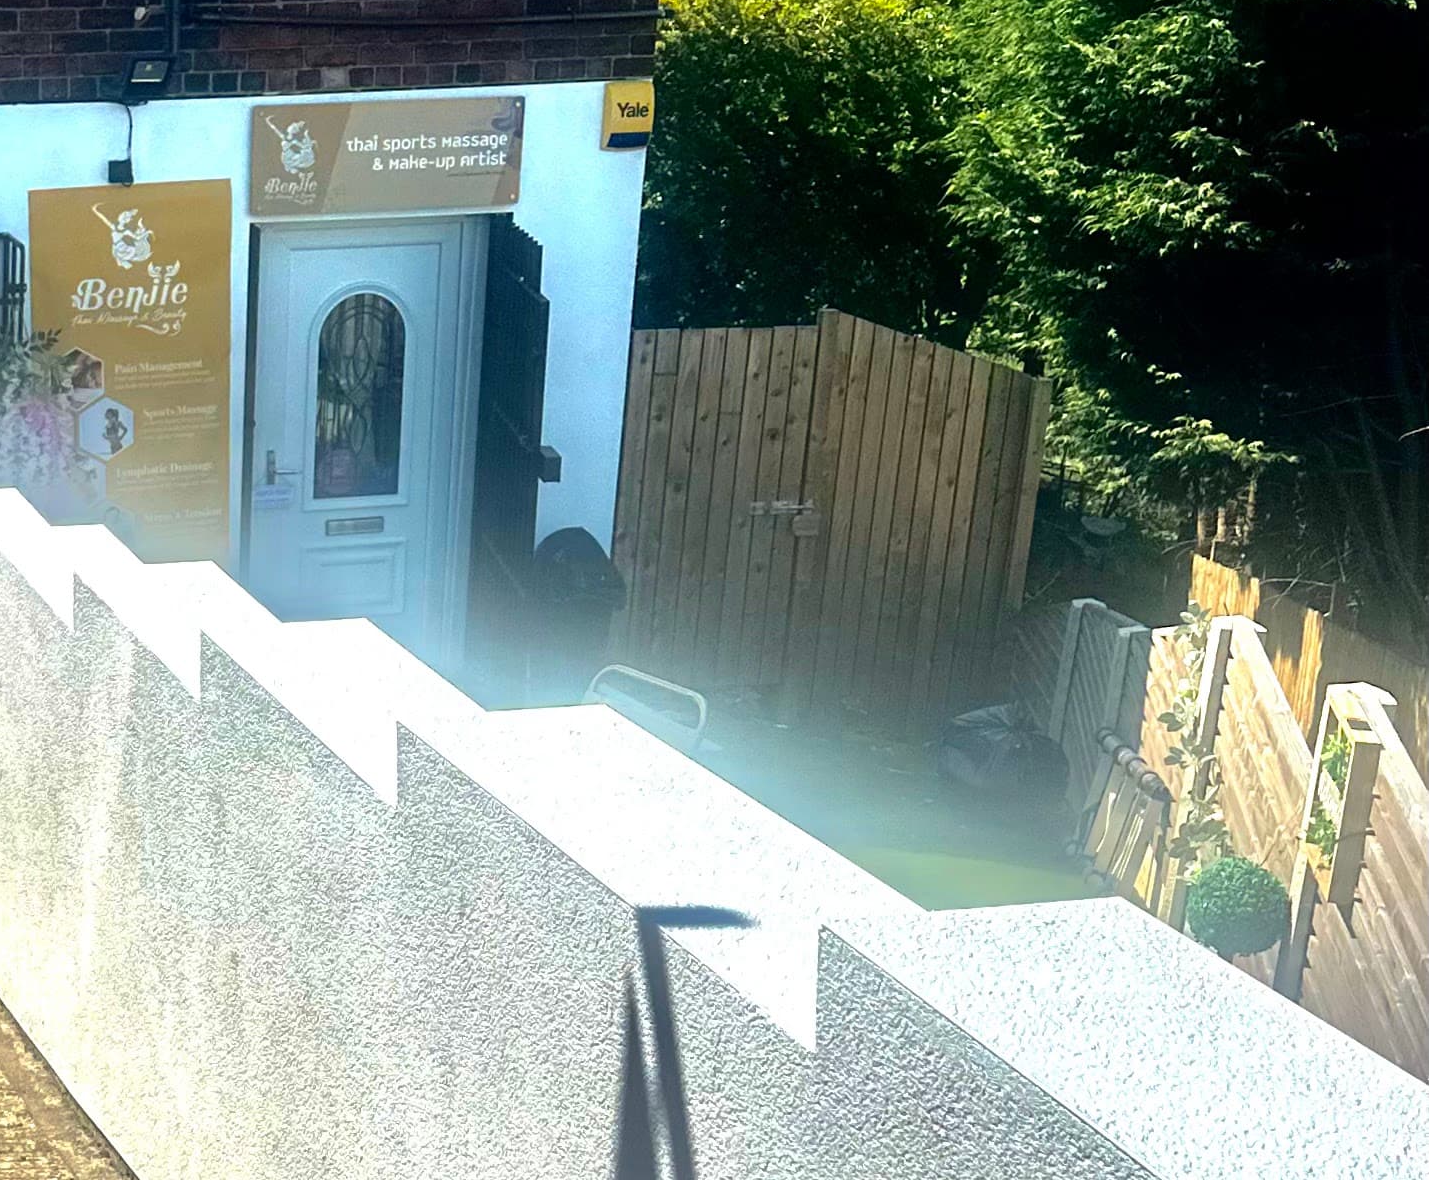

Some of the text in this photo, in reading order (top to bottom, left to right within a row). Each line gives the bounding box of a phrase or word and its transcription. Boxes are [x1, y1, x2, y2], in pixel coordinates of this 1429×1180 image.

[617, 102, 649, 118] Yale
[382, 134, 436, 153] sports
[372, 157, 384, 171] &
[71, 276, 188, 314] Benjie
